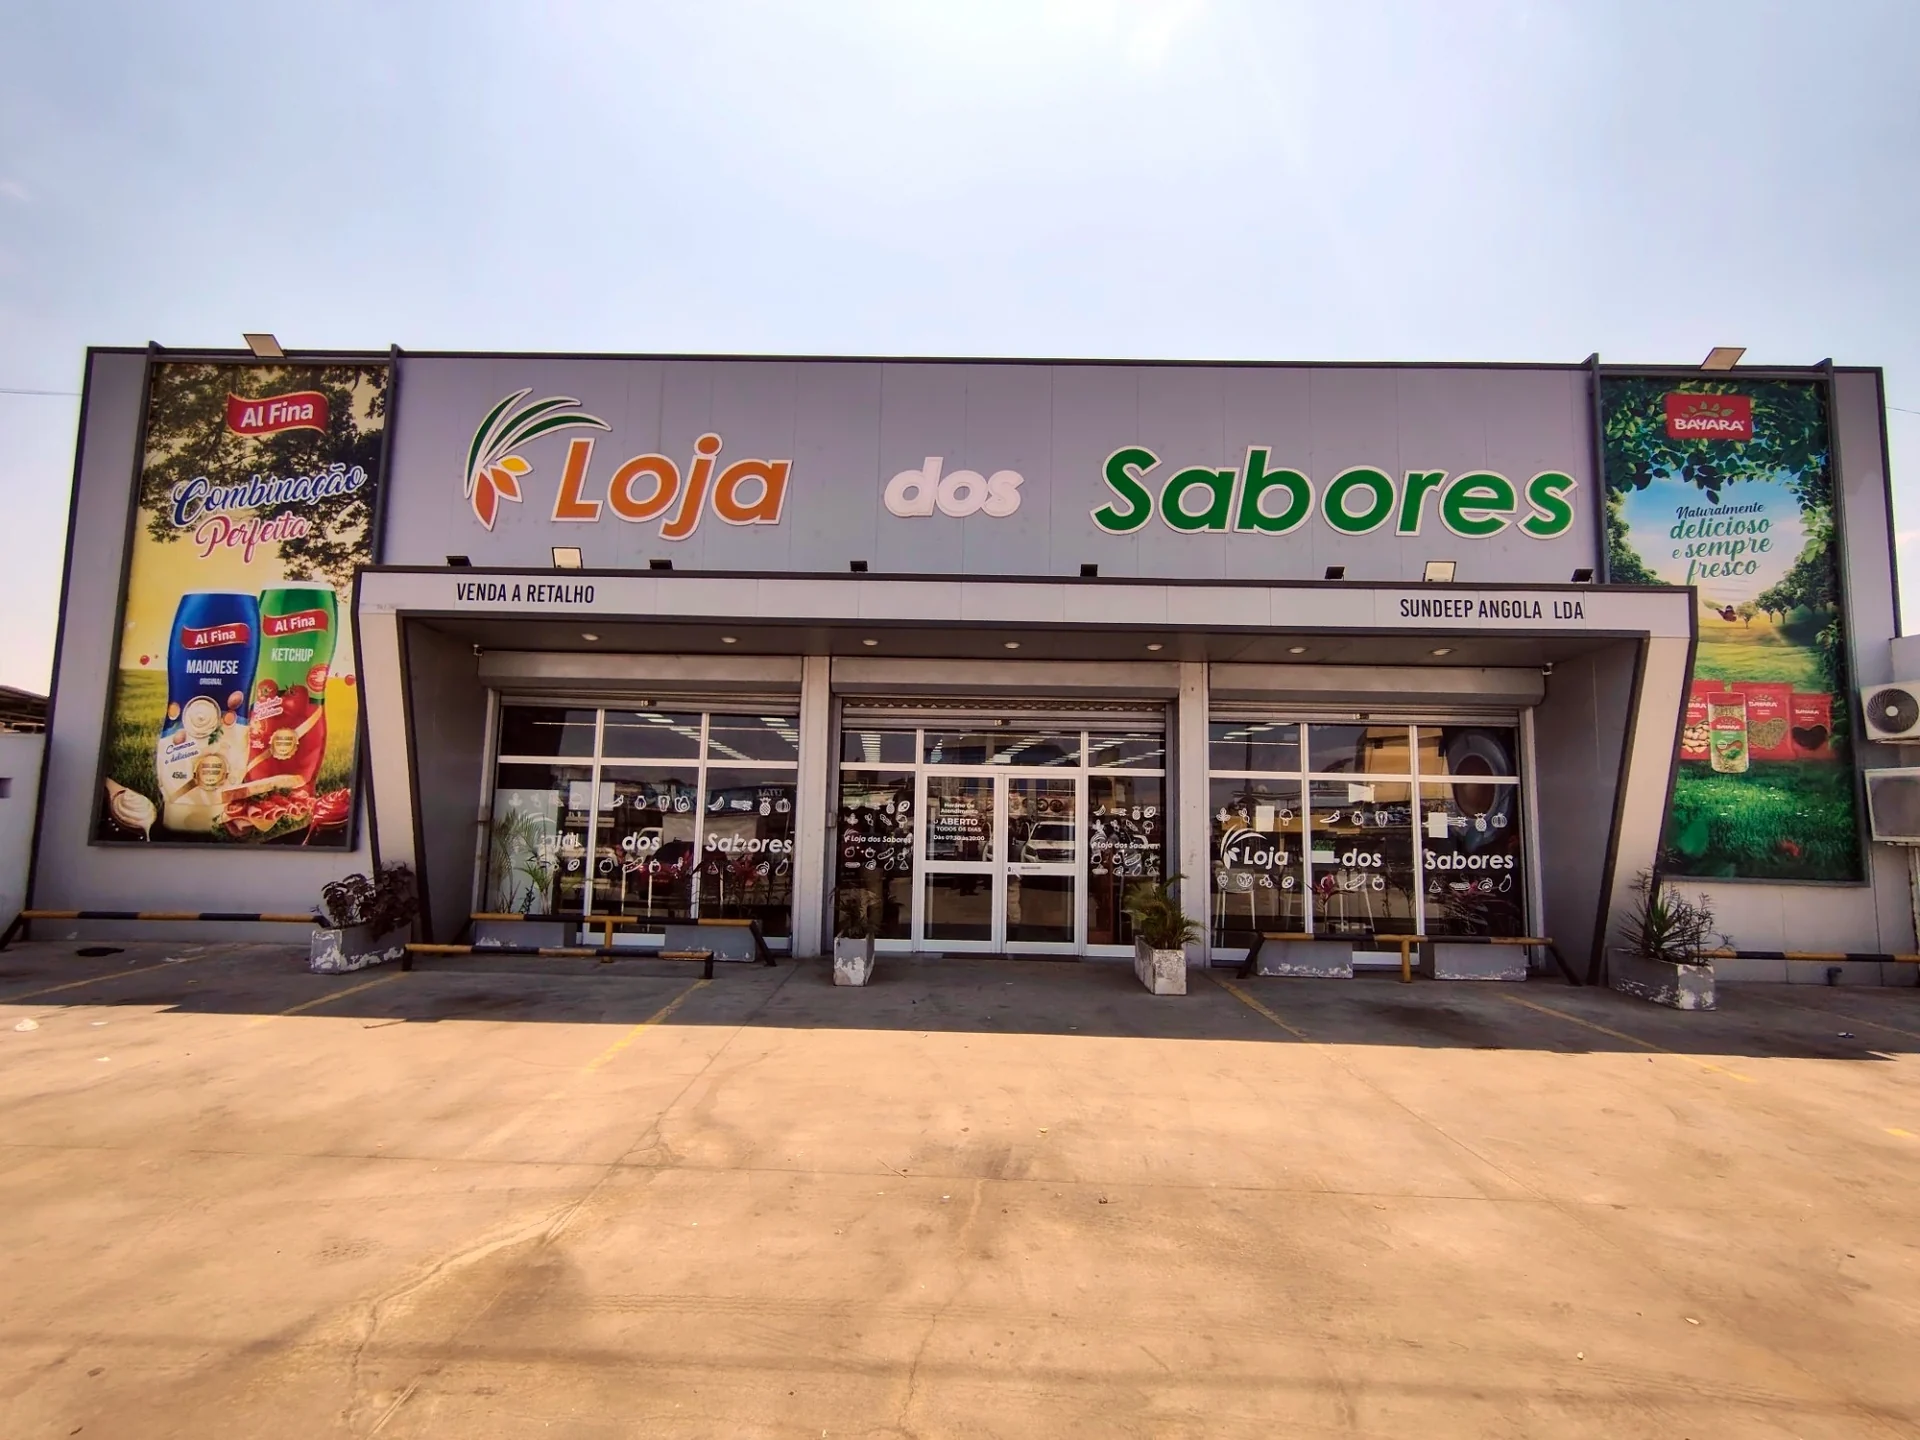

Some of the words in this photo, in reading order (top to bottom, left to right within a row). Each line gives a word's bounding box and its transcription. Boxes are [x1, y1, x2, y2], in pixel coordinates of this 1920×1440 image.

[240, 407, 264, 428] Al
[268, 402, 314, 425] Fina
[1674, 418, 1744, 432] BAYARA
[173, 463, 368, 527] Combinação
[550, 432, 793, 541] Loja
[883, 456, 1025, 518] dos
[1089, 445, 1579, 540] Sabores
[1675, 501, 1765, 520] Naturalmente
[195, 511, 311, 564] Perfeita
[1669, 516, 1773, 540] delicioso
[1672, 549, 1681, 559] e
[1684, 535, 1773, 561] sempre
[1686, 558, 1760, 586] fresco
[457, 582, 507, 601] VENDA
[511, 584, 521, 602] A
[526, 584, 595, 604] RETALHO
[1400, 598, 1473, 618] SUNDEEP
[1478, 599, 1542, 619] ANGOLA
[1554, 601, 1584, 620] LDA
[275, 619, 288, 633] Al
[291, 615, 316, 630] Fina
[195, 633, 208, 645] Al
[211, 629, 237, 643] Fina
[271, 648, 314, 662] KETCHUP
[186, 659, 239, 675] MAIONESE
[940, 818, 978, 826] ABERTO
[621, 831, 661, 851] dos
[705, 833, 793, 853] Sabores
[851, 835, 866, 843] Loja
[867, 835, 881, 843] dos
[1097, 841, 1113, 850] Loja
[1114, 841, 1128, 849] dos
[1243, 846, 1289, 869] Loja
[1342, 848, 1382, 867] dos
[1424, 851, 1514, 870] Sabores
